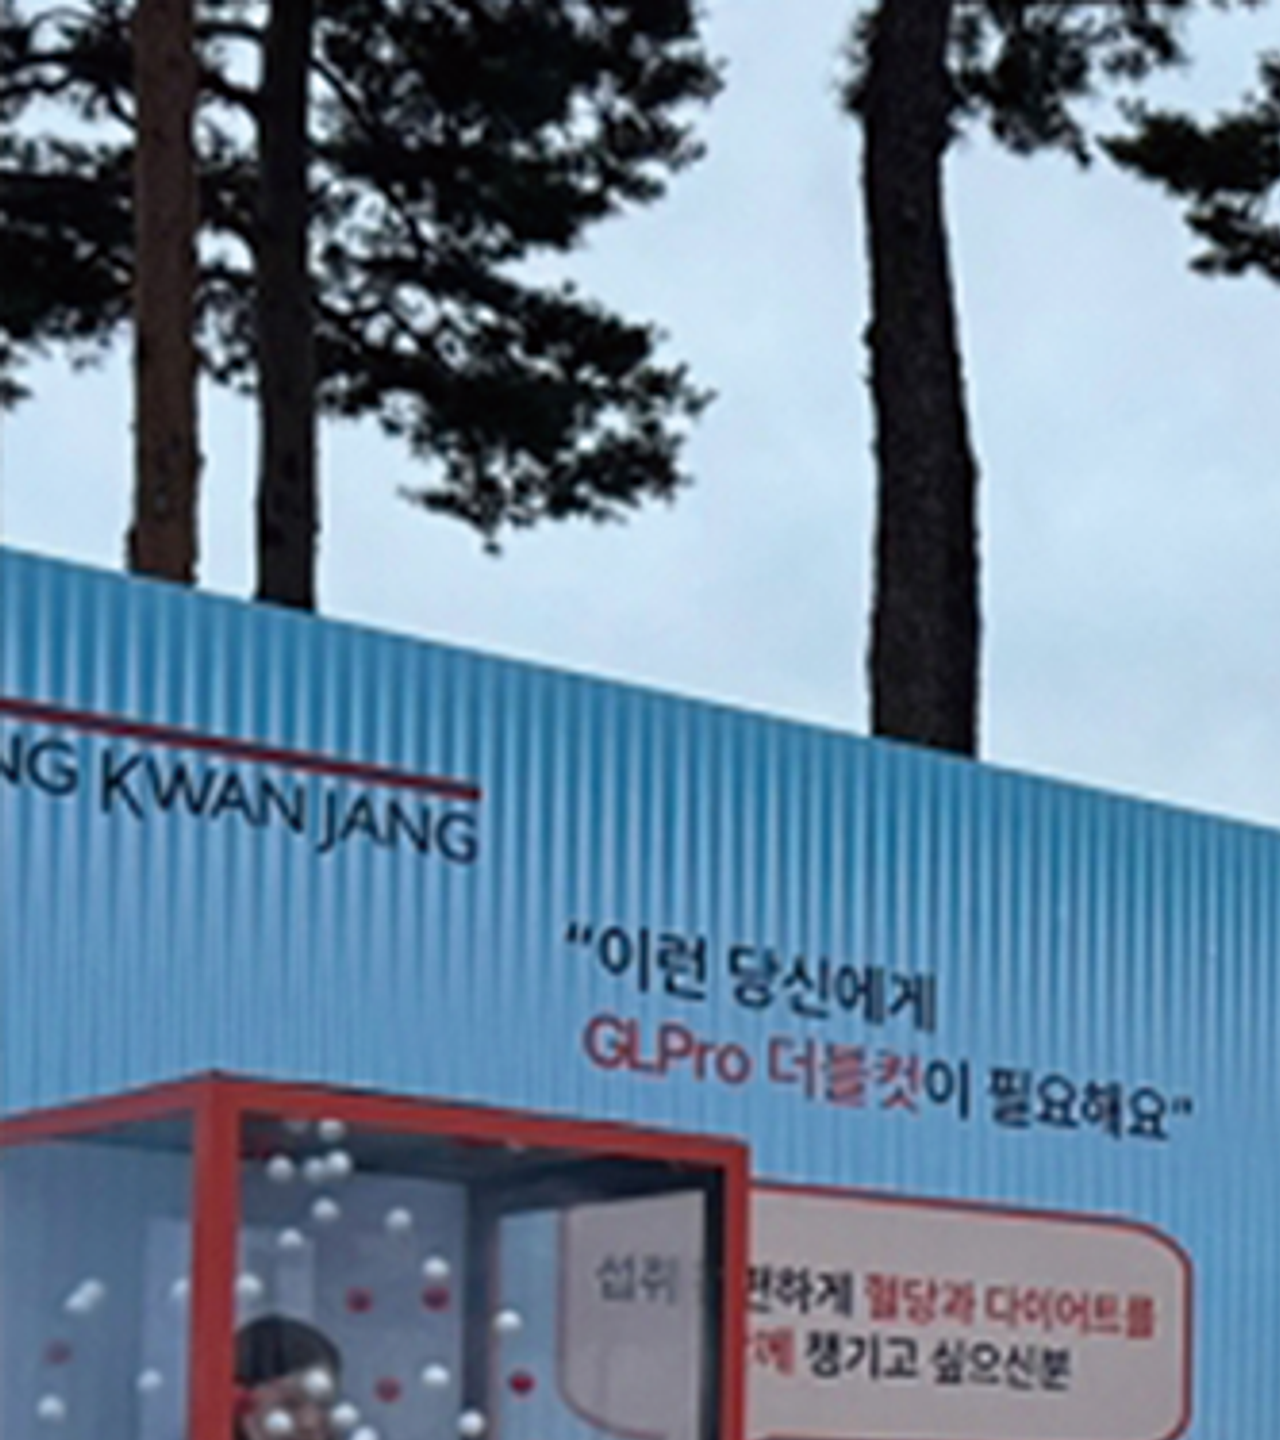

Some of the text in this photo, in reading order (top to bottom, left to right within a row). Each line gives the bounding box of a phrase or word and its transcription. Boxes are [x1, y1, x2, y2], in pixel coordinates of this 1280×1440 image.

[100, 750, 306, 834] KWAN
[314, 792, 480, 866] JANG
[728, 945, 937, 1032] 당신에게
[582, 1014, 752, 1086] GLPro
[767, 1036, 971, 1120] 더블컷이
[864, 1272, 975, 1326] 혈당과
[985, 1283, 1156, 1340] 다이어트를
[804, 1328, 919, 1382] 챙기고
